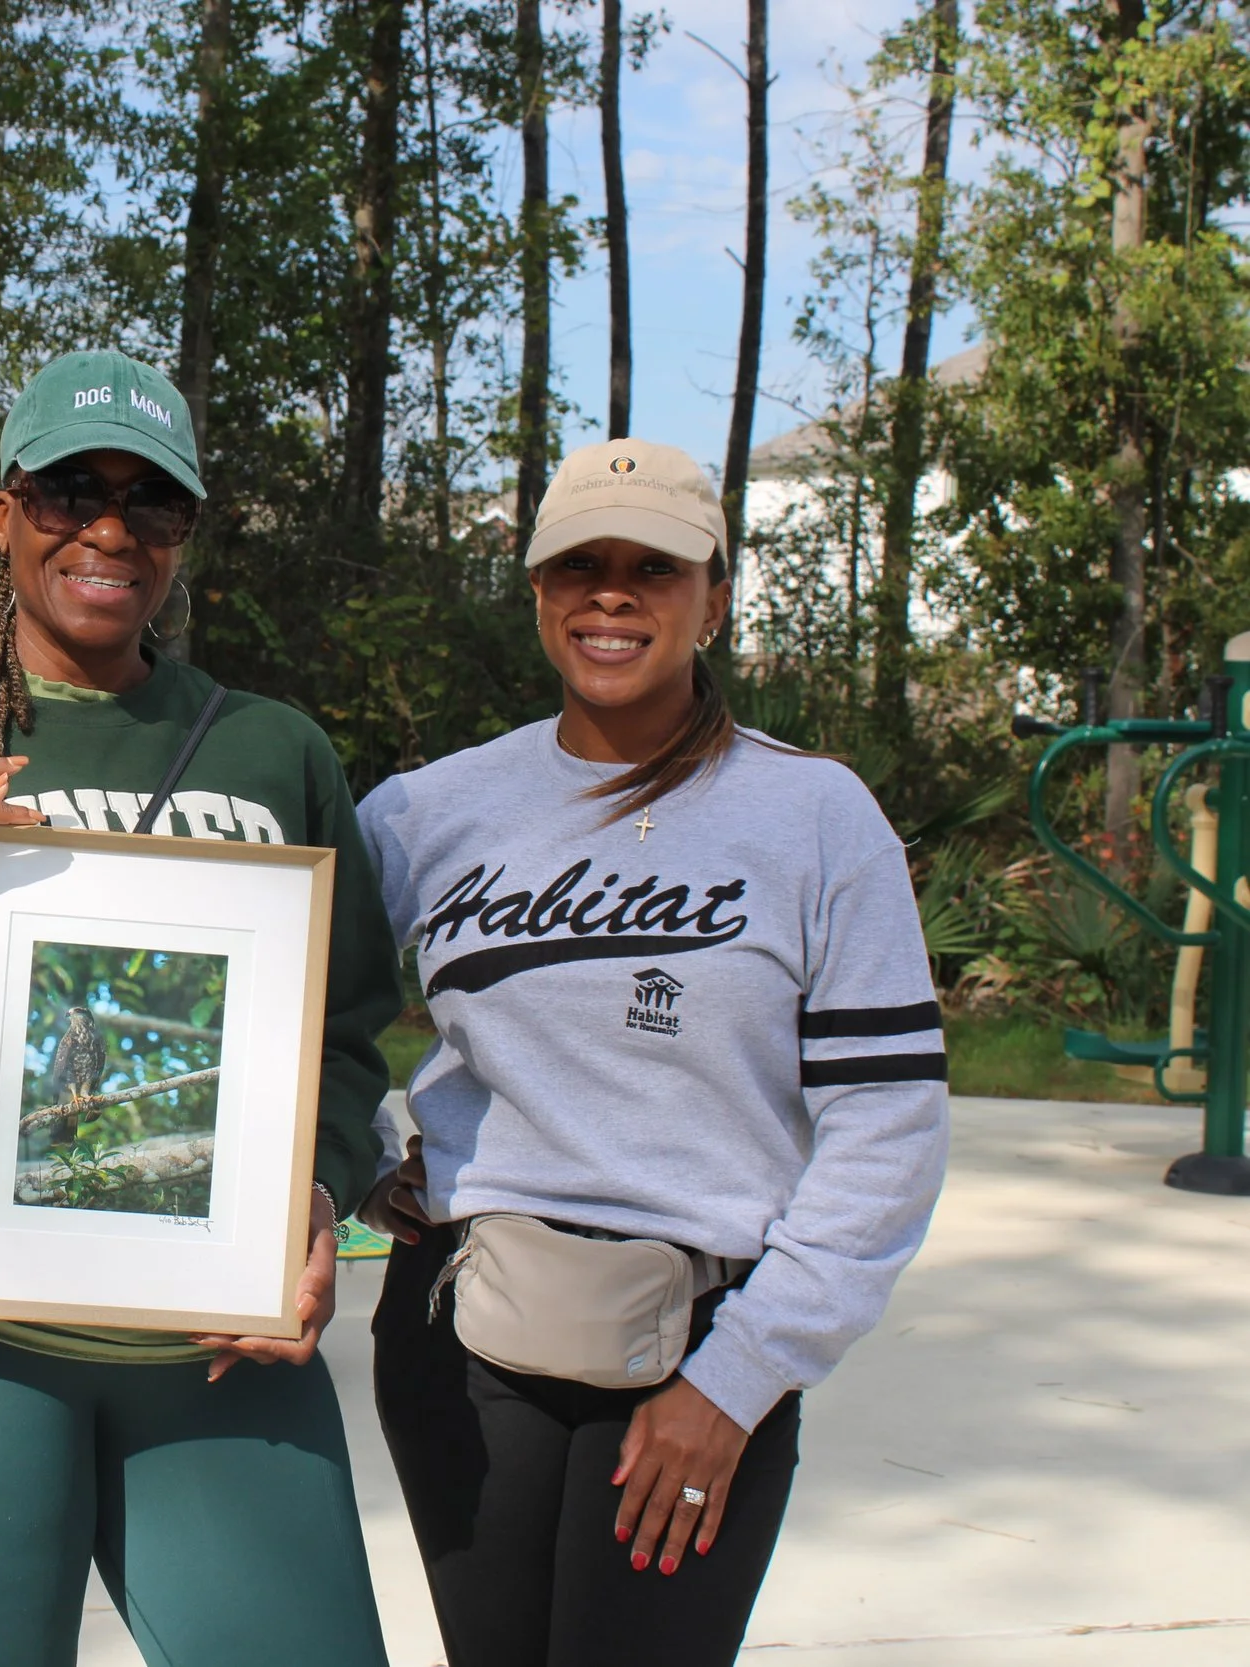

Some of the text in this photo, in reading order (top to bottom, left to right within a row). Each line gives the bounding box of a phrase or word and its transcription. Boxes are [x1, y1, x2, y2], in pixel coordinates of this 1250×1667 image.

[73, 385, 173, 429] DOG MOM
[618, 475, 679, 498] Landing
[423, 857, 748, 953] Habitat
[626, 1005, 680, 1028] Habitat
[626, 1019, 638, 1029] for
